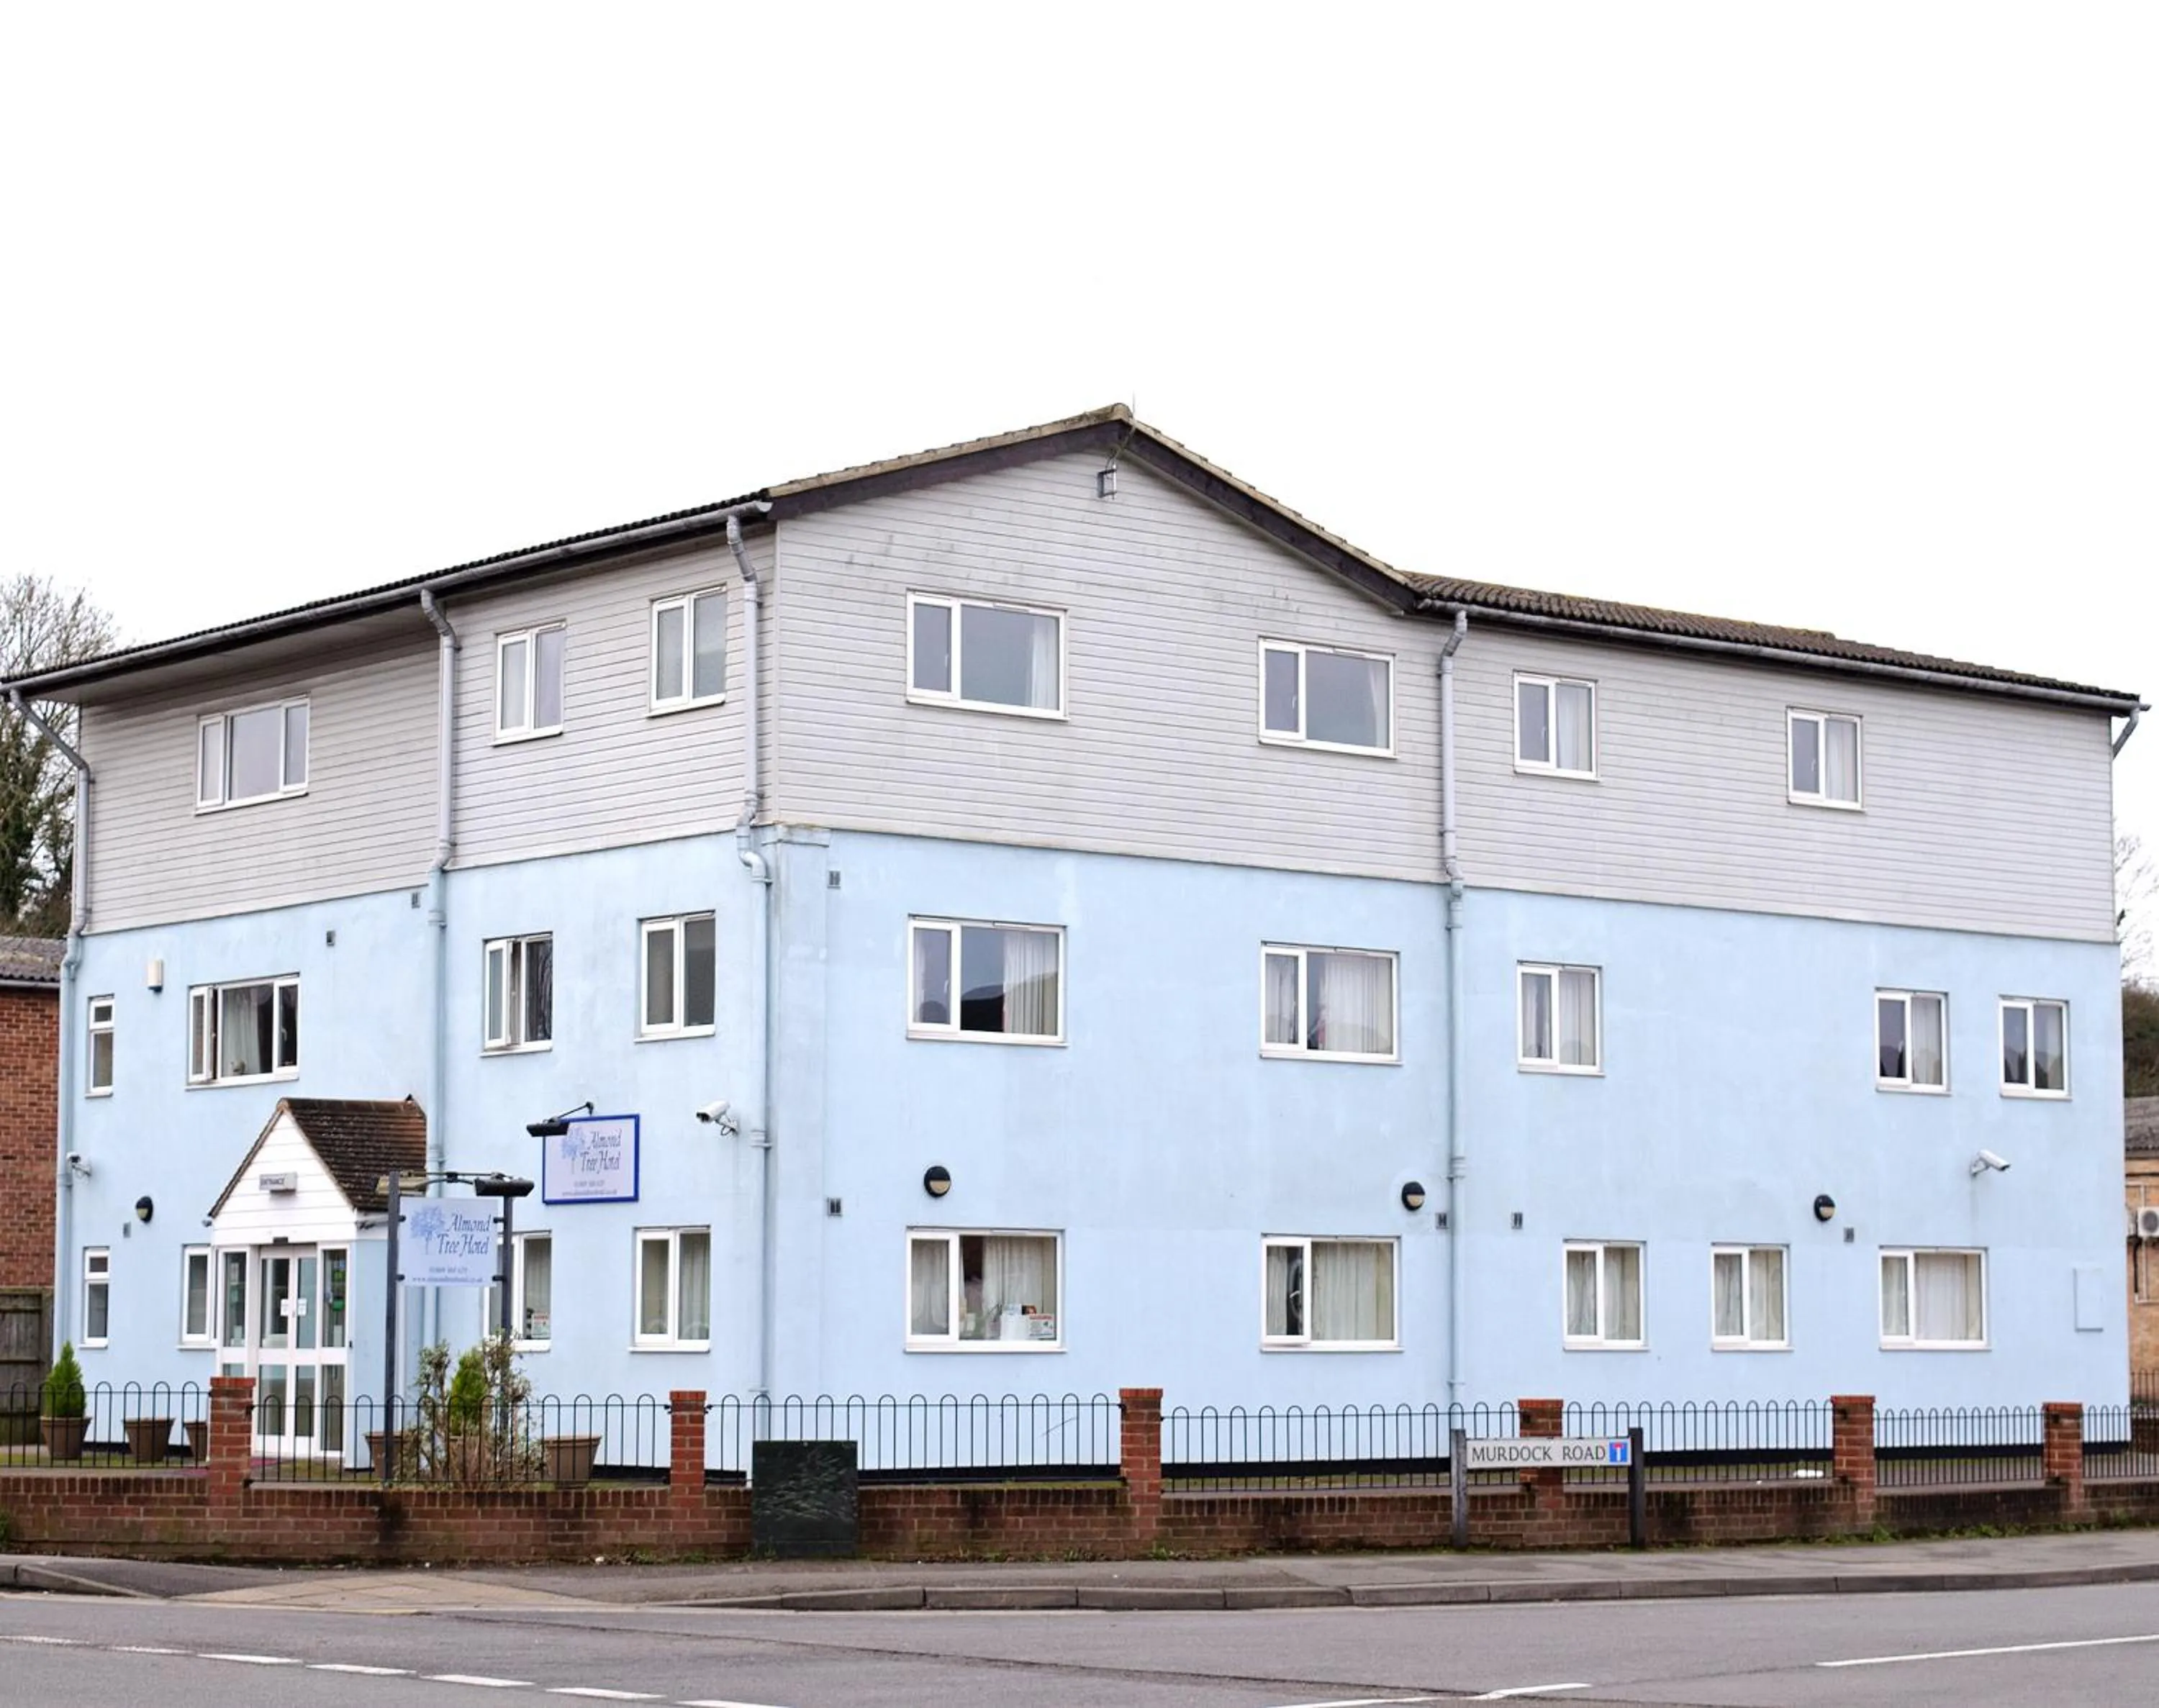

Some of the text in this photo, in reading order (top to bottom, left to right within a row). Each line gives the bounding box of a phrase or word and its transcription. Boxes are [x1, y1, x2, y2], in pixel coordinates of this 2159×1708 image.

[446, 1212, 492, 1232] Almond
[437, 1233, 490, 1257] Tree Hotel
[1471, 1445, 1606, 1463] MURDOCK ROAD
